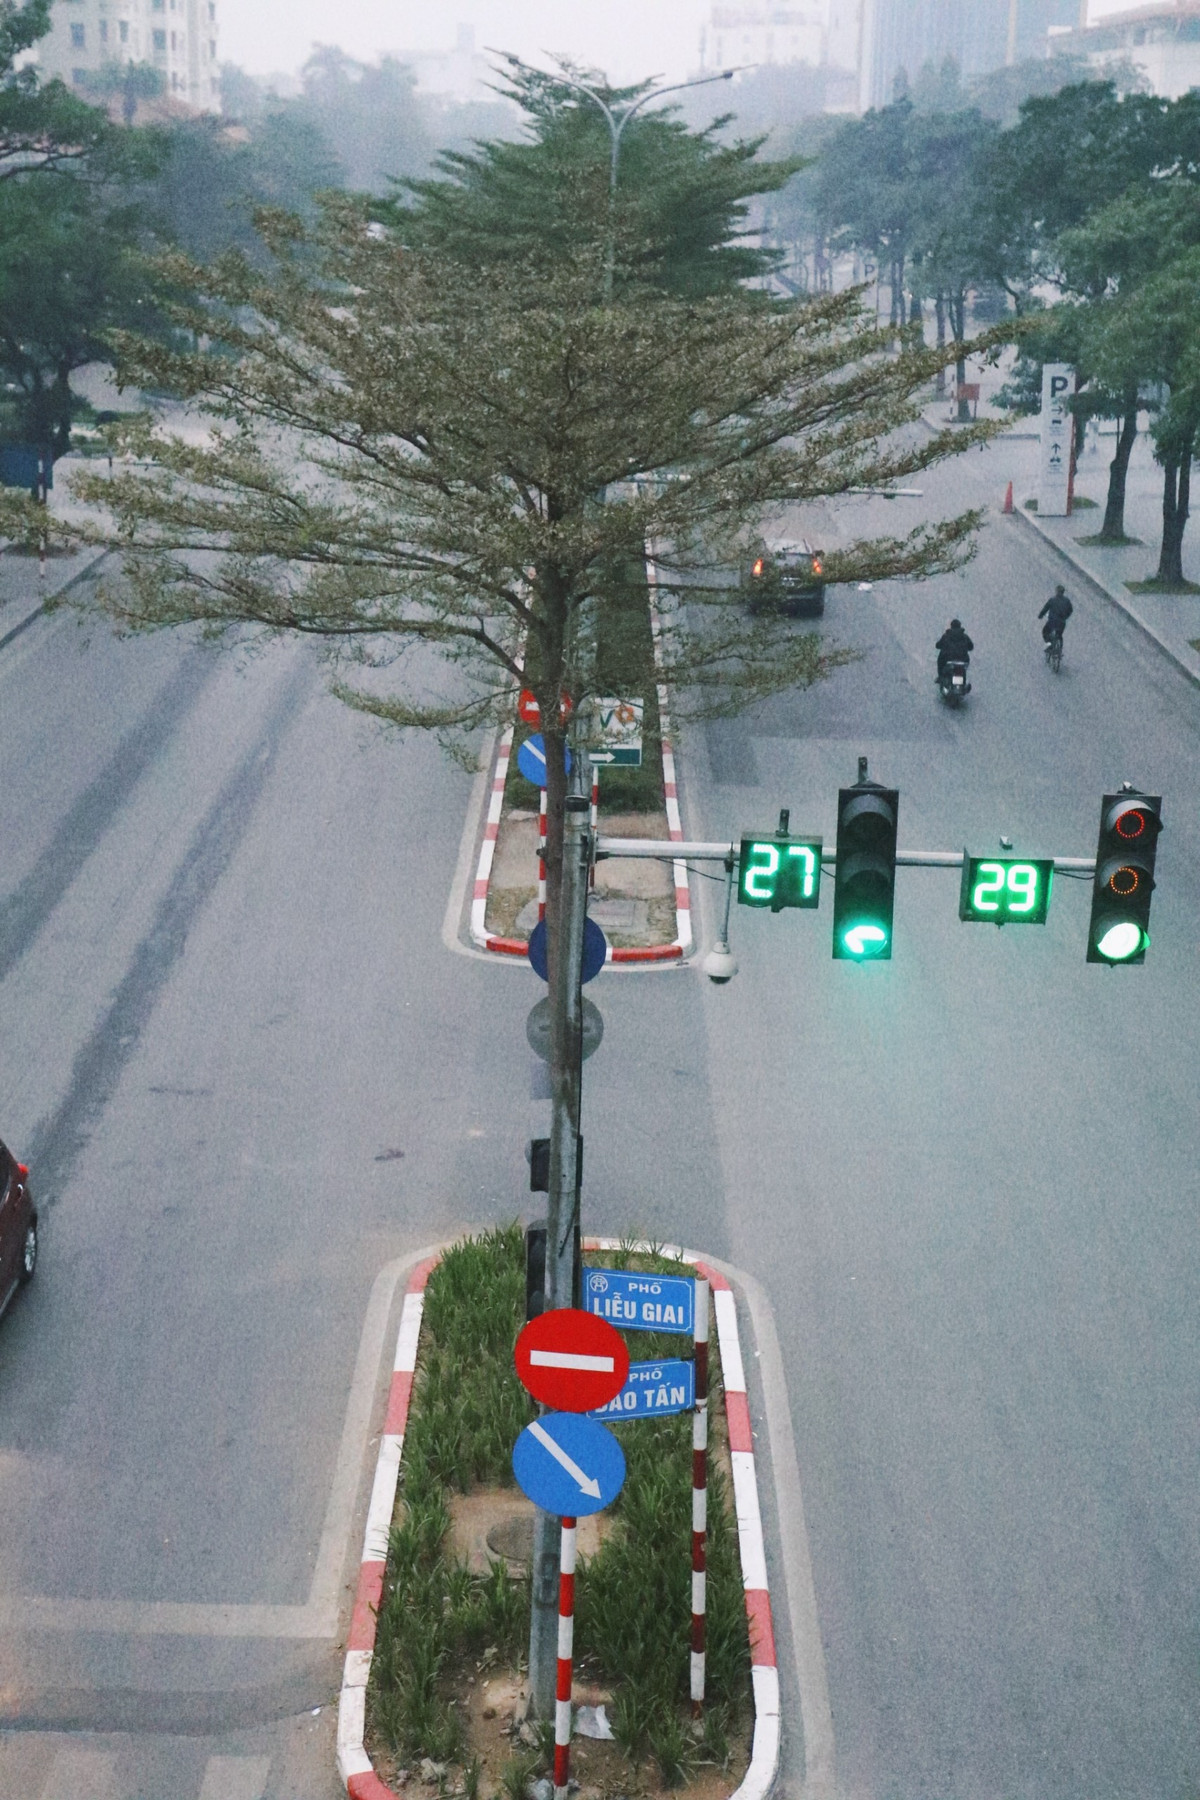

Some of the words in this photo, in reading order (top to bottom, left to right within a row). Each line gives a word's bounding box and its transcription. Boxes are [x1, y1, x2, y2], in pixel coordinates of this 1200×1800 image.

[864, 264, 876, 277] P
[1051, 376, 1069, 398] P
[744, 843, 815, 899] 27
[973, 863, 1038, 912] 29
[628, 1282, 662, 1295] PHỐ
[593, 1292, 637, 1320] LIỄU
[642, 1302, 684, 1325] GIAI
[629, 1366, 664, 1383] PHỐ
[643, 1382, 685, 1408] TẤN
